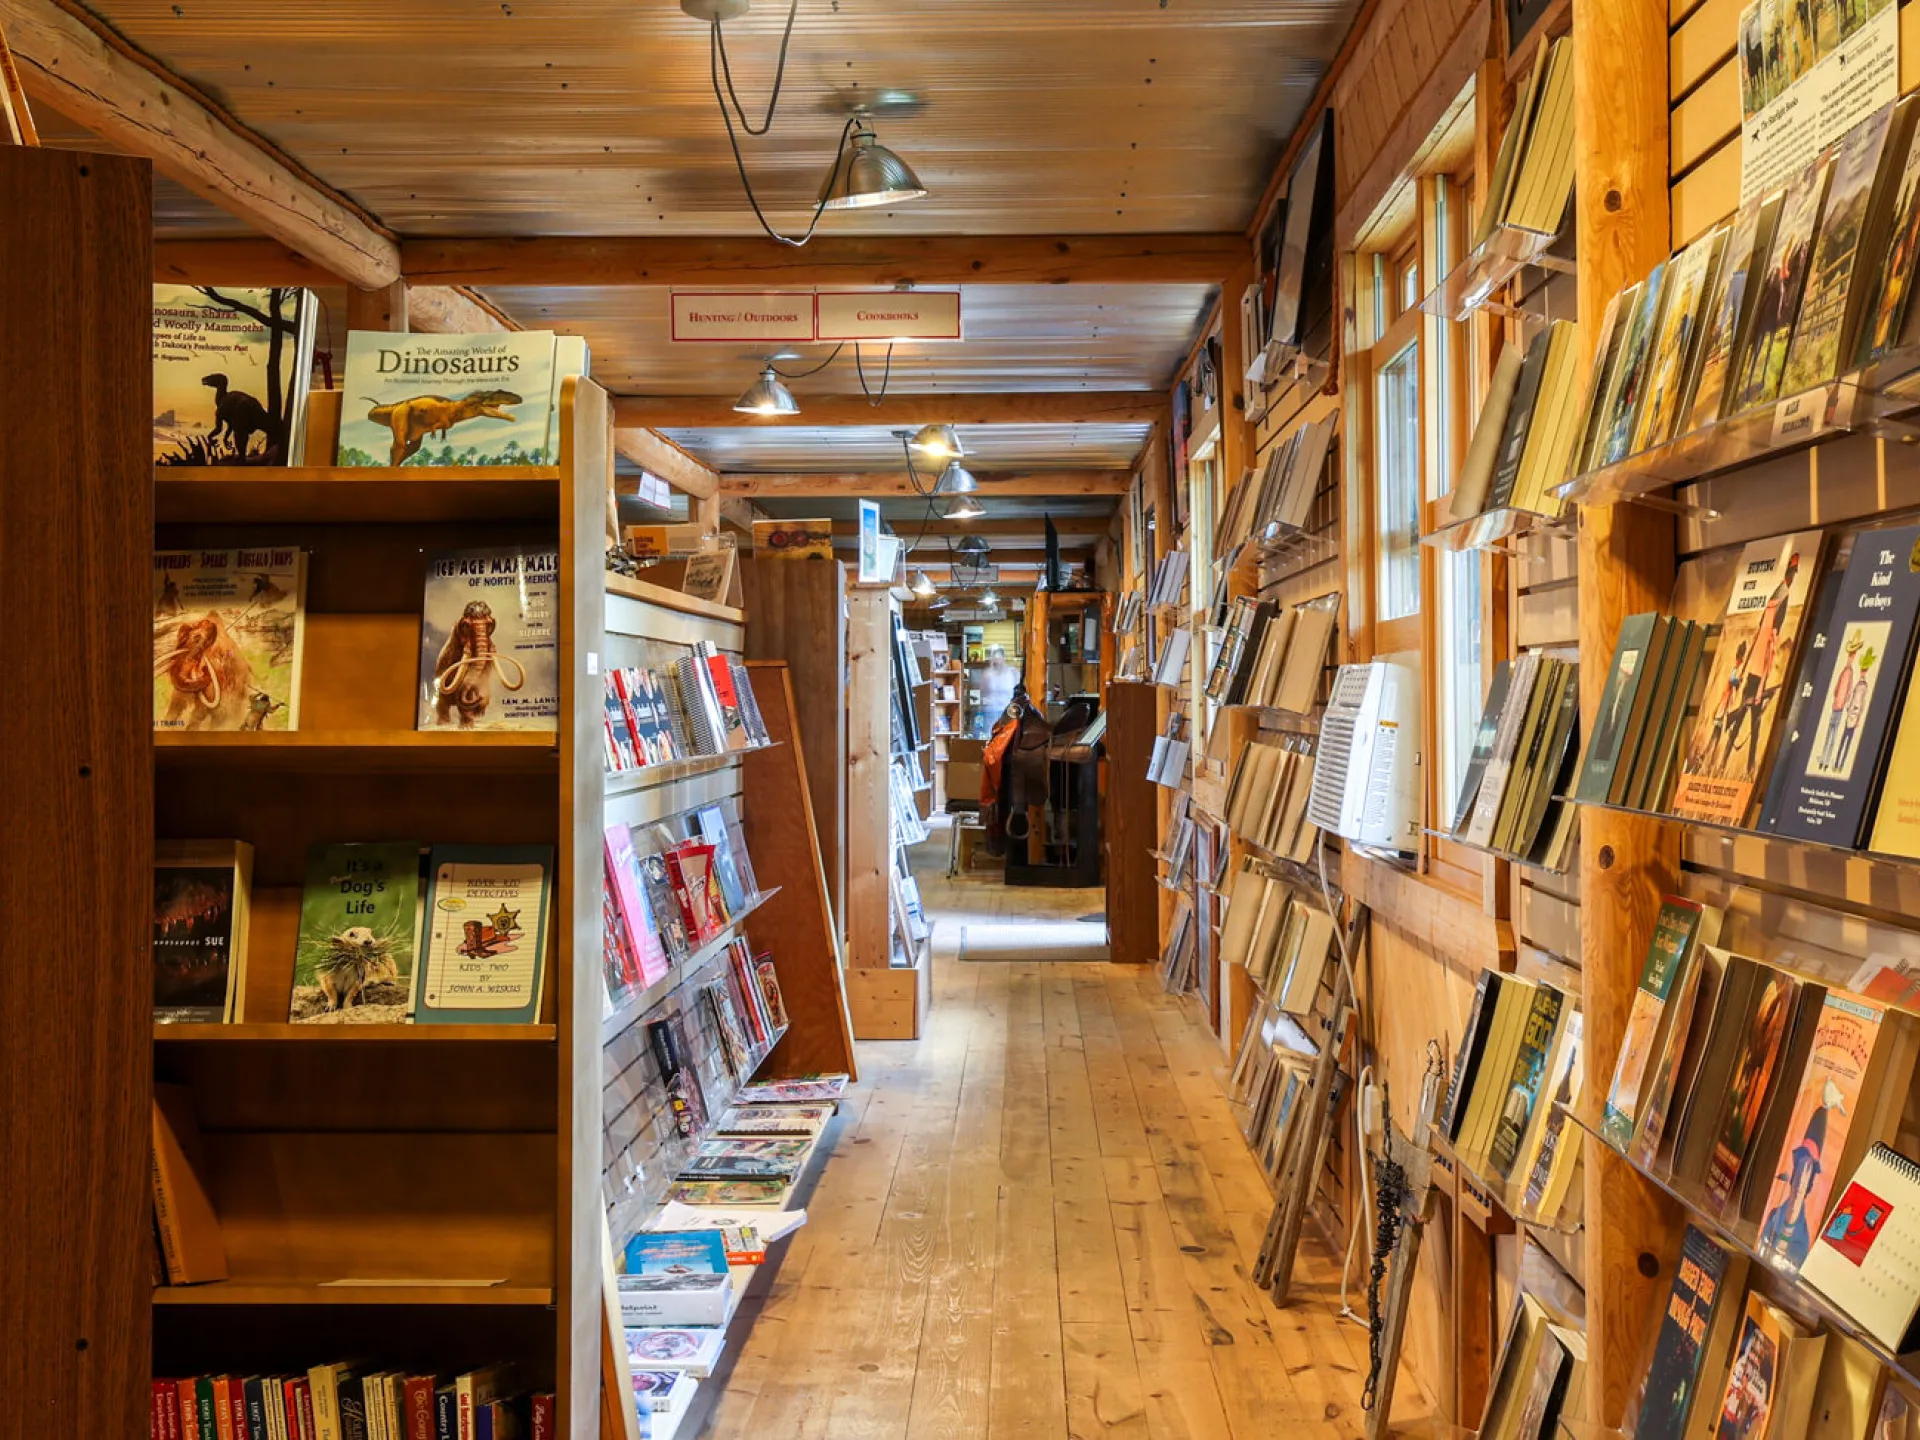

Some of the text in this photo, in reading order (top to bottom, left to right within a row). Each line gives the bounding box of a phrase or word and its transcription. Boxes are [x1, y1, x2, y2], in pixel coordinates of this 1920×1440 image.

[154, 307, 198, 319] nosaurs,
[164, 319, 201, 333] Woolly
[204, 321, 264, 333] Mammoths
[416, 345, 507, 357] The Amazing World of
[376, 349, 520, 375] Dinosaurs
[1879, 549, 1895, 565] The
[436, 560, 455, 577] ICE
[459, 558, 486, 576] AGE
[469, 573, 558, 587] OF NORTH MERICA
[1870, 570, 1893, 587] Kind
[1858, 592, 1893, 611] Cowboys
[534, 696, 558, 704] LANG
[346, 859, 369, 872] It's
[340, 880, 385, 895] Dog's
[346, 900, 376, 915] Life
[204, 936, 224, 947] SUE
[479, 974, 491, 982] BY
[439, 1395, 448, 1434] Country
